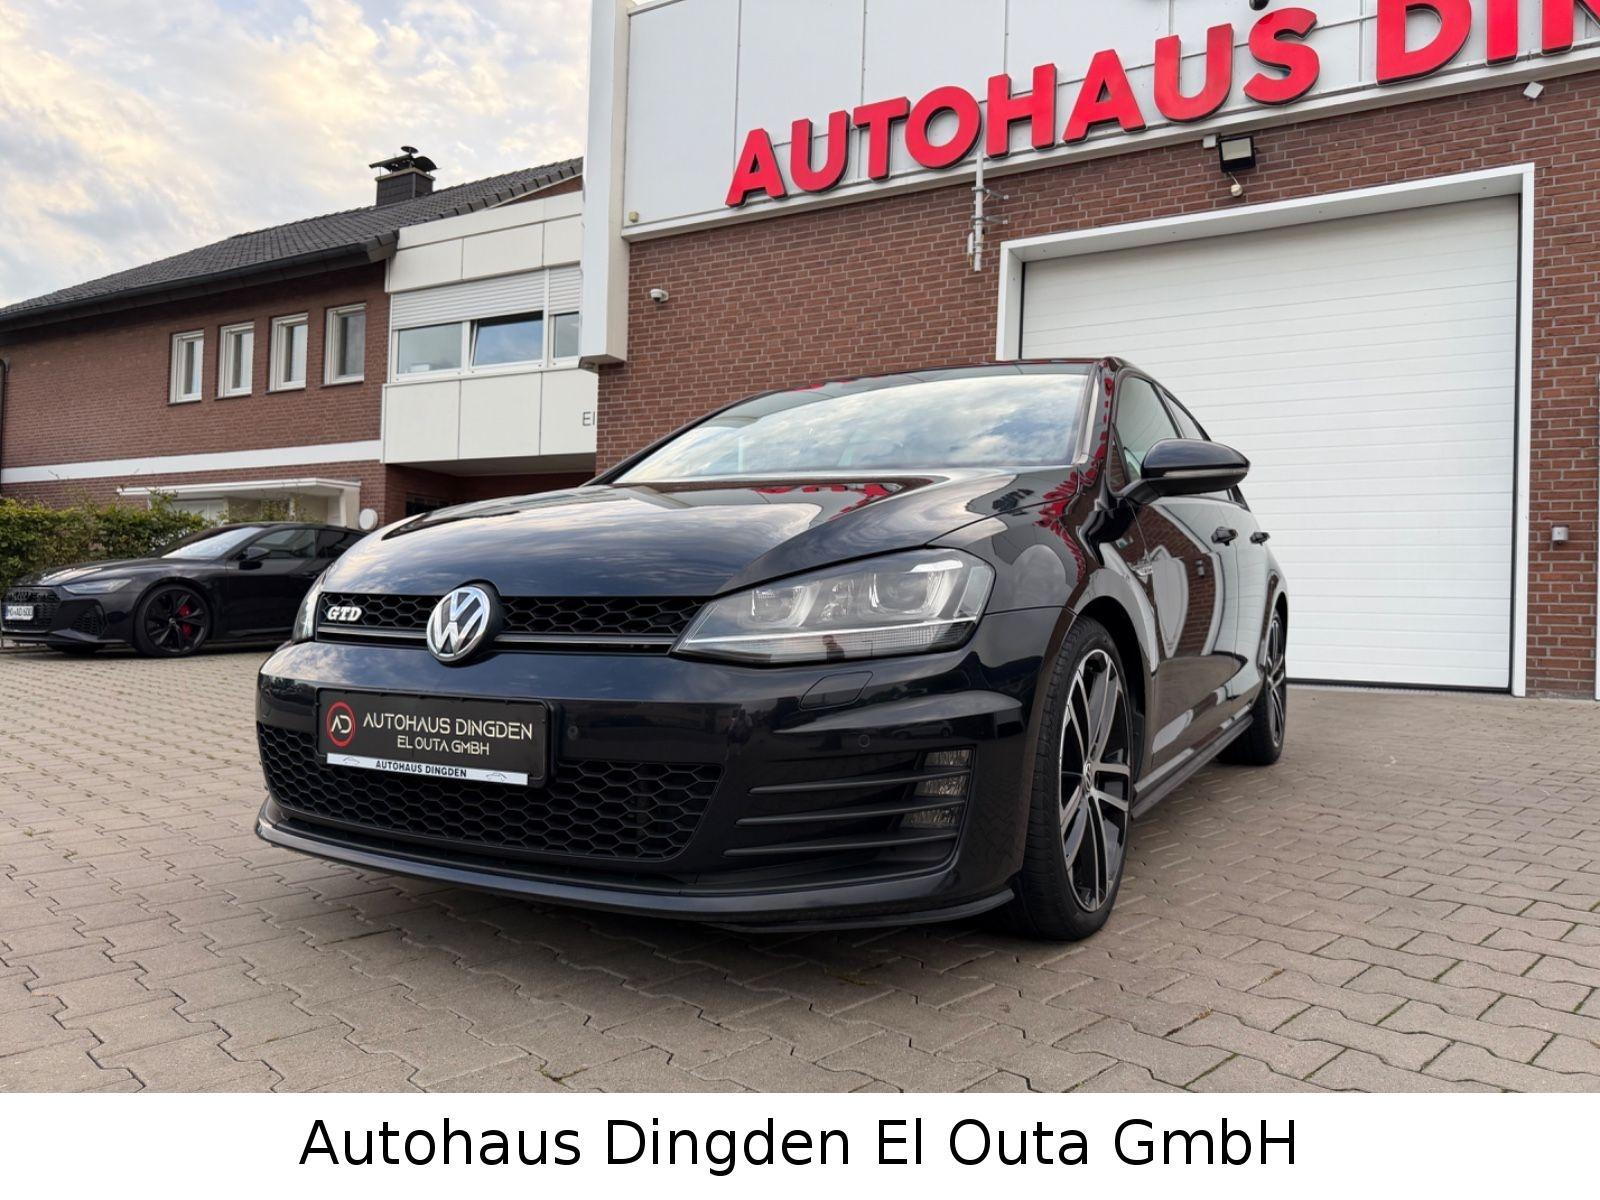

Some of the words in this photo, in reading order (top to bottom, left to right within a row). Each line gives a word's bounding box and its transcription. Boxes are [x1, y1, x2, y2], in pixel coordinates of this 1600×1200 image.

[726, 7, 1321, 207] AUTOHAUS
[326, 605, 363, 622] GTD
[362, 711, 451, 736] AUTOHAUS
[455, 718, 533, 741] DINGDEN
[397, 735, 413, 749] EL
[415, 737, 449, 753] OUTA
[451, 740, 490, 756] GMBH
[375, 760, 423, 774] AUTOHAUS
[425, 765, 468, 778] DINGDEN
